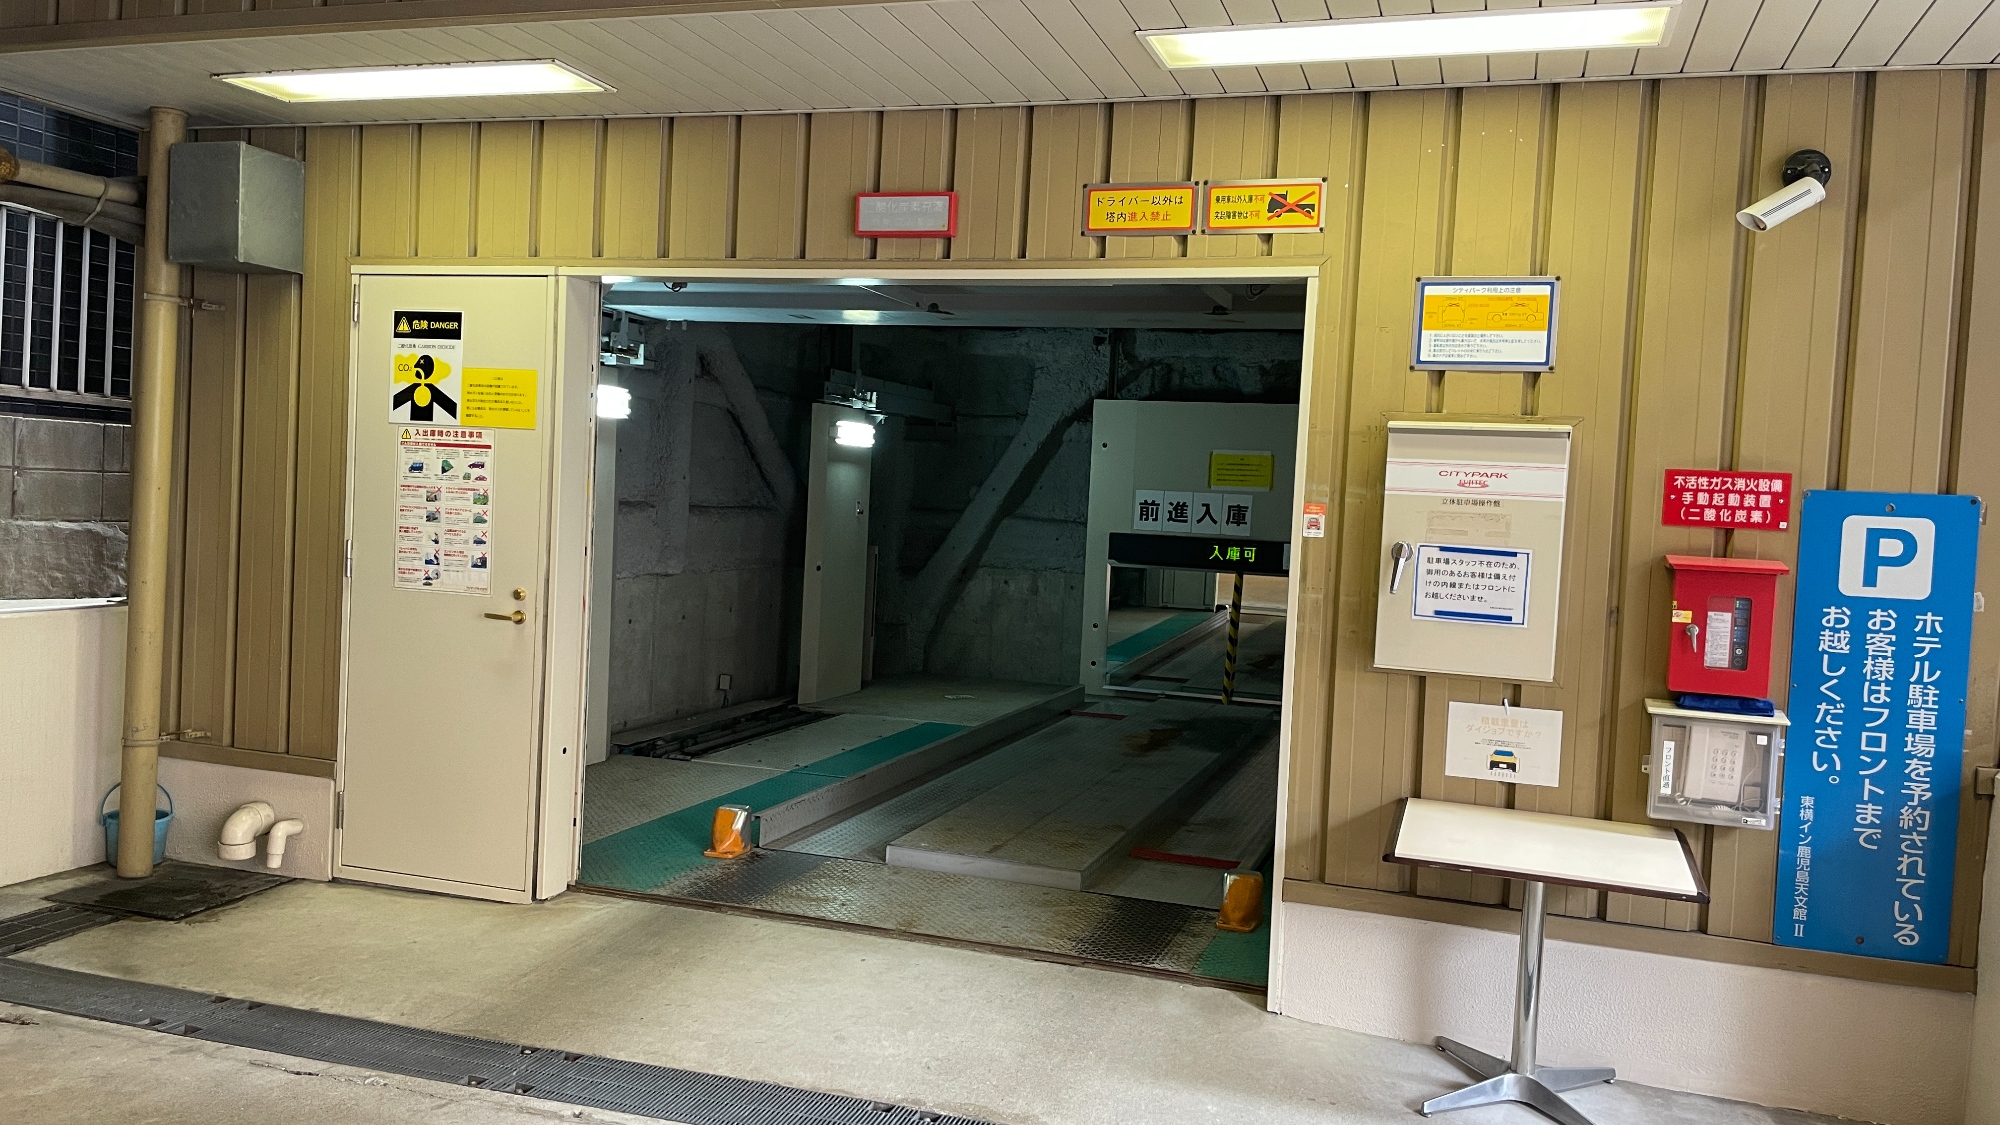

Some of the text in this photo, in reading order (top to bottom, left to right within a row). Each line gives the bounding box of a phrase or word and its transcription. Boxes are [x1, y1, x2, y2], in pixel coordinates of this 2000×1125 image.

[1097, 195, 1184, 207] ドライバー以外は
[1215, 194, 1265, 204] 乗用車以外入庫不可
[1105, 211, 1171, 222] 塔内進入禁止
[1214, 210, 1260, 220] 突起障害物は不可
[412, 320, 458, 330] 危険 DANGER
[414, 428, 482, 439] 入出庫時の注意事項
[1438, 470, 1510, 479] CITYPARK
[1674, 476, 1782, 492] 不活性ガス消火設備
[1442, 498, 1501, 508] 立体駐車場操作盤
[1682, 492, 1772, 508] 手動起動装置
[1138, 499, 1249, 526] 前進入庫
[1680, 507, 1771, 524] （二酸化炭素）
[1208, 546, 1256, 562] 入庫可
[1862, 528, 1918, 588] P
[1426, 557, 1520, 570] 駐車場スタッフ不在のため、
[1426, 568, 1516, 581] 御用のあるお客様は備え付
[1426, 580, 1516, 592] けの内線またはフロントに
[1424, 592, 1488, 602] お越しくださいませ。
[1812, 605, 1852, 787] お越しください。
[1480, 716, 1529, 728] 積載重量は
[1853, 608, 1898, 851] お客様はフロントまで
[1892, 611, 1944, 948] ホテル駐車場を予約されている
